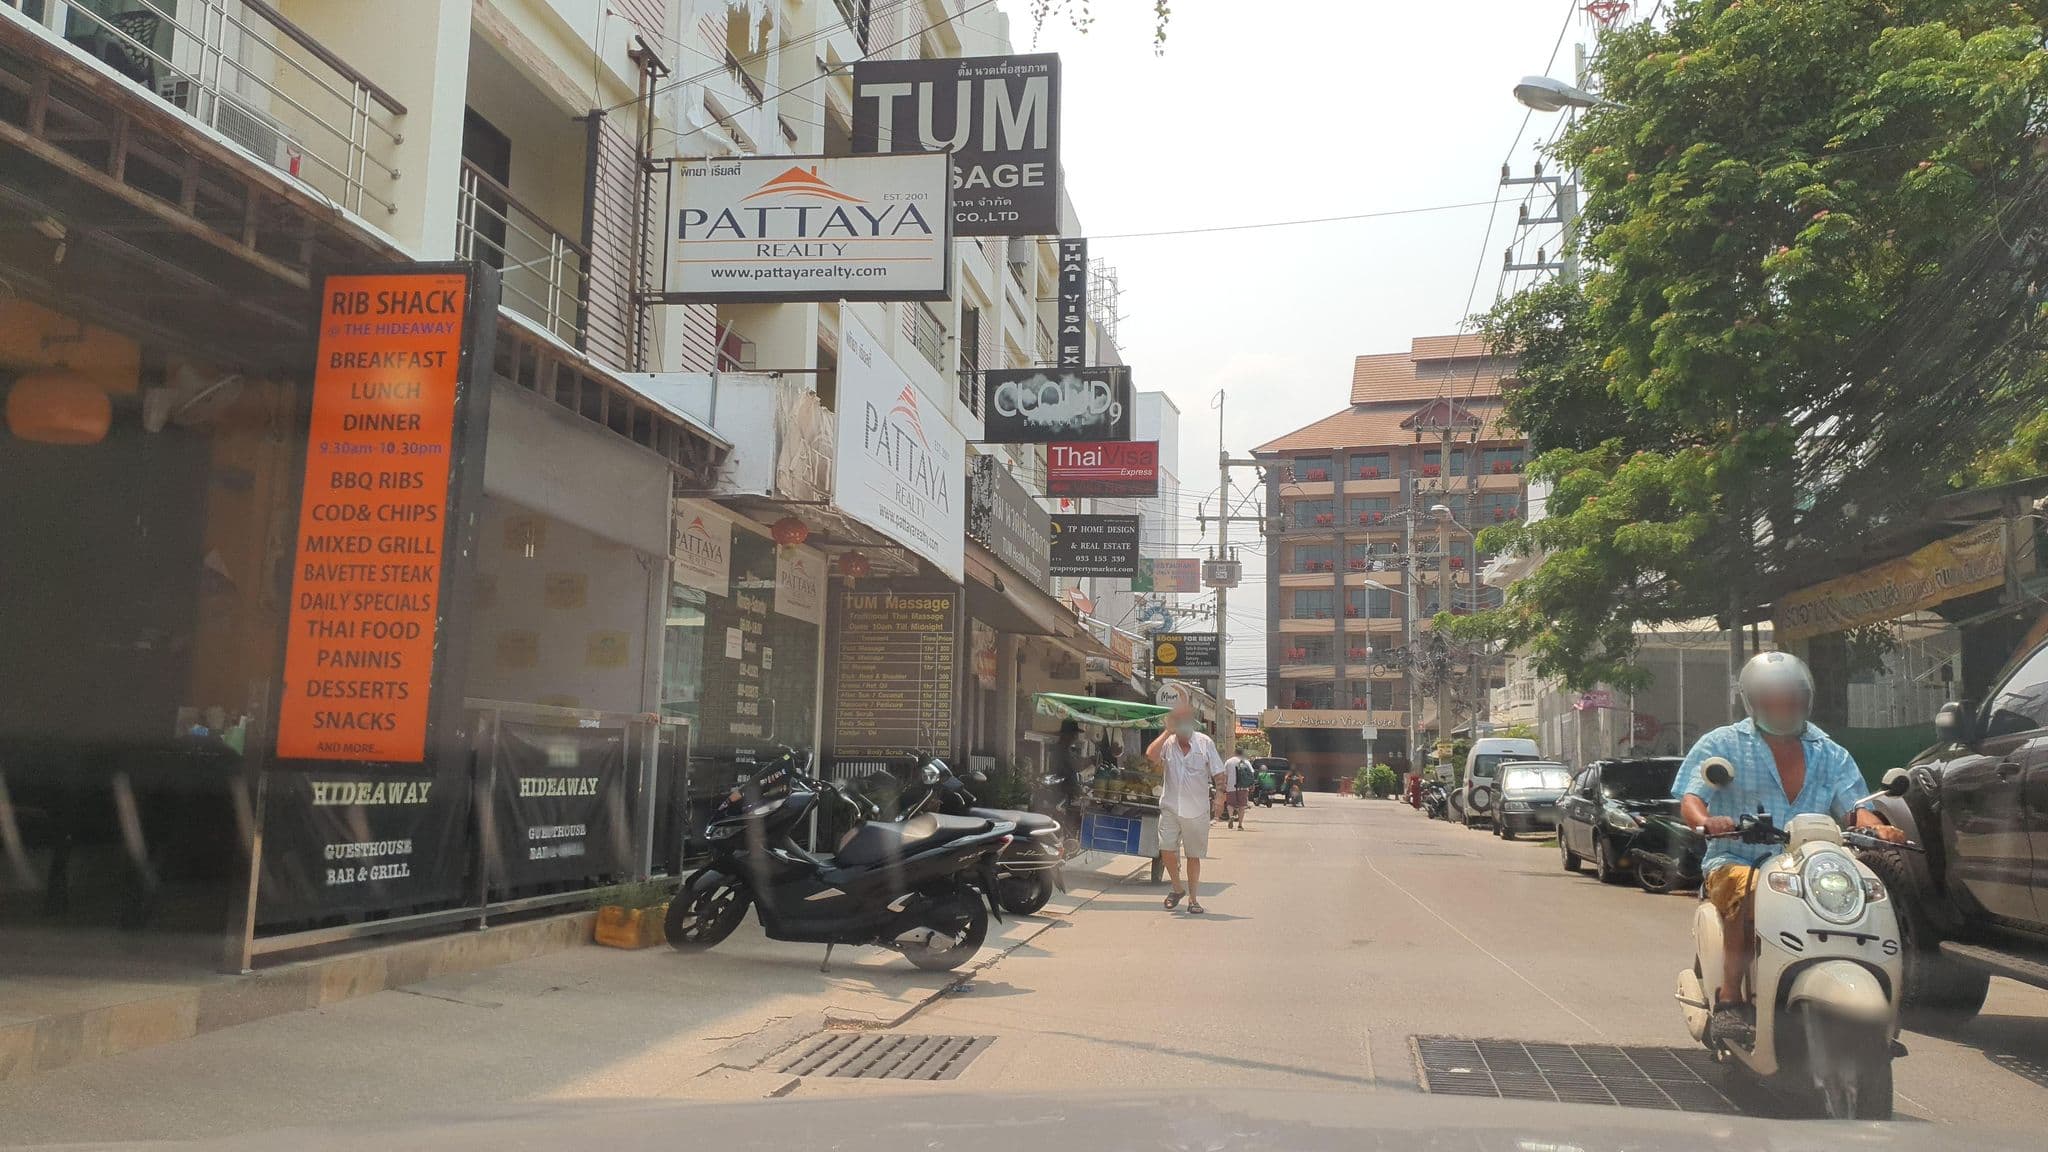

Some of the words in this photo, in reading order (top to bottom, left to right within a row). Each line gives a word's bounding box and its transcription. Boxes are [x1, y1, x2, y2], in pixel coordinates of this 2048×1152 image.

[860, 75, 1048, 154] TUM
[953, 162, 1045, 190] SAGE
[905, 192, 929, 201] 2001
[678, 203, 933, 240] PATTAYA
[756, 243, 848, 258] REALTY
[1064, 243, 1081, 282] THAI
[710, 265, 887, 281] www.pattayarealty.com
[331, 291, 371, 316] RIB
[376, 291, 457, 316] SHACK
[343, 322, 371, 336] THE
[375, 321, 455, 335] HIDEAWAY
[330, 351, 448, 369] BREAKFAST
[350, 382, 421, 400] LUNCH
[994, 380, 1113, 418] CLOUD
[1109, 401, 1123, 426] 9
[342, 414, 421, 431] DINNER
[864, 400, 950, 514] PATTAYA
[1052, 446, 1102, 467] Thai
[330, 471, 373, 491] BBQ
[378, 471, 424, 489] RIBS
[1120, 468, 1153, 477] Express
[895, 482, 927, 520] REALTY
[377, 504, 438, 522] CHIPS
[1067, 525, 1078, 534] TP
[1081, 525, 1104, 534] HOME
[1107, 525, 1136, 534] DESIGN
[304, 535, 372, 554] MIXED
[377, 535, 436, 555] GRILL
[675, 528, 723, 563] PATTAYA
[1070, 542, 1078, 550] &
[1080, 542, 1101, 550] REAL
[1103, 542, 1132, 550] ESTATE
[303, 563, 377, 582] BAVETTE
[381, 564, 433, 583] STEAK
[1050, 566, 1134, 574] ayapropertymarket.com
[781, 570, 817, 595] PATTAYA
[299, 592, 350, 611] DAILY
[353, 592, 431, 613] SPECIALS
[847, 595, 878, 609] TUM
[886, 595, 951, 612] Massage
[911, 612, 945, 621] Massage
[307, 620, 354, 638] THAI
[360, 620, 421, 640] FOOD
[910, 623, 944, 632] Midnight
[316, 650, 402, 669] PANINIS
[306, 680, 409, 700] DESSERTS
[312, 711, 397, 731] SNACKS
[317, 741, 341, 753] AND
[311, 781, 432, 806] HIDEAWAY
[519, 777, 599, 798] HIDEAWAY
[325, 839, 413, 860] GUESTHOUSE
[326, 867, 355, 886] BAR
[357, 866, 368, 882] &
[370, 863, 411, 881] GRILL
